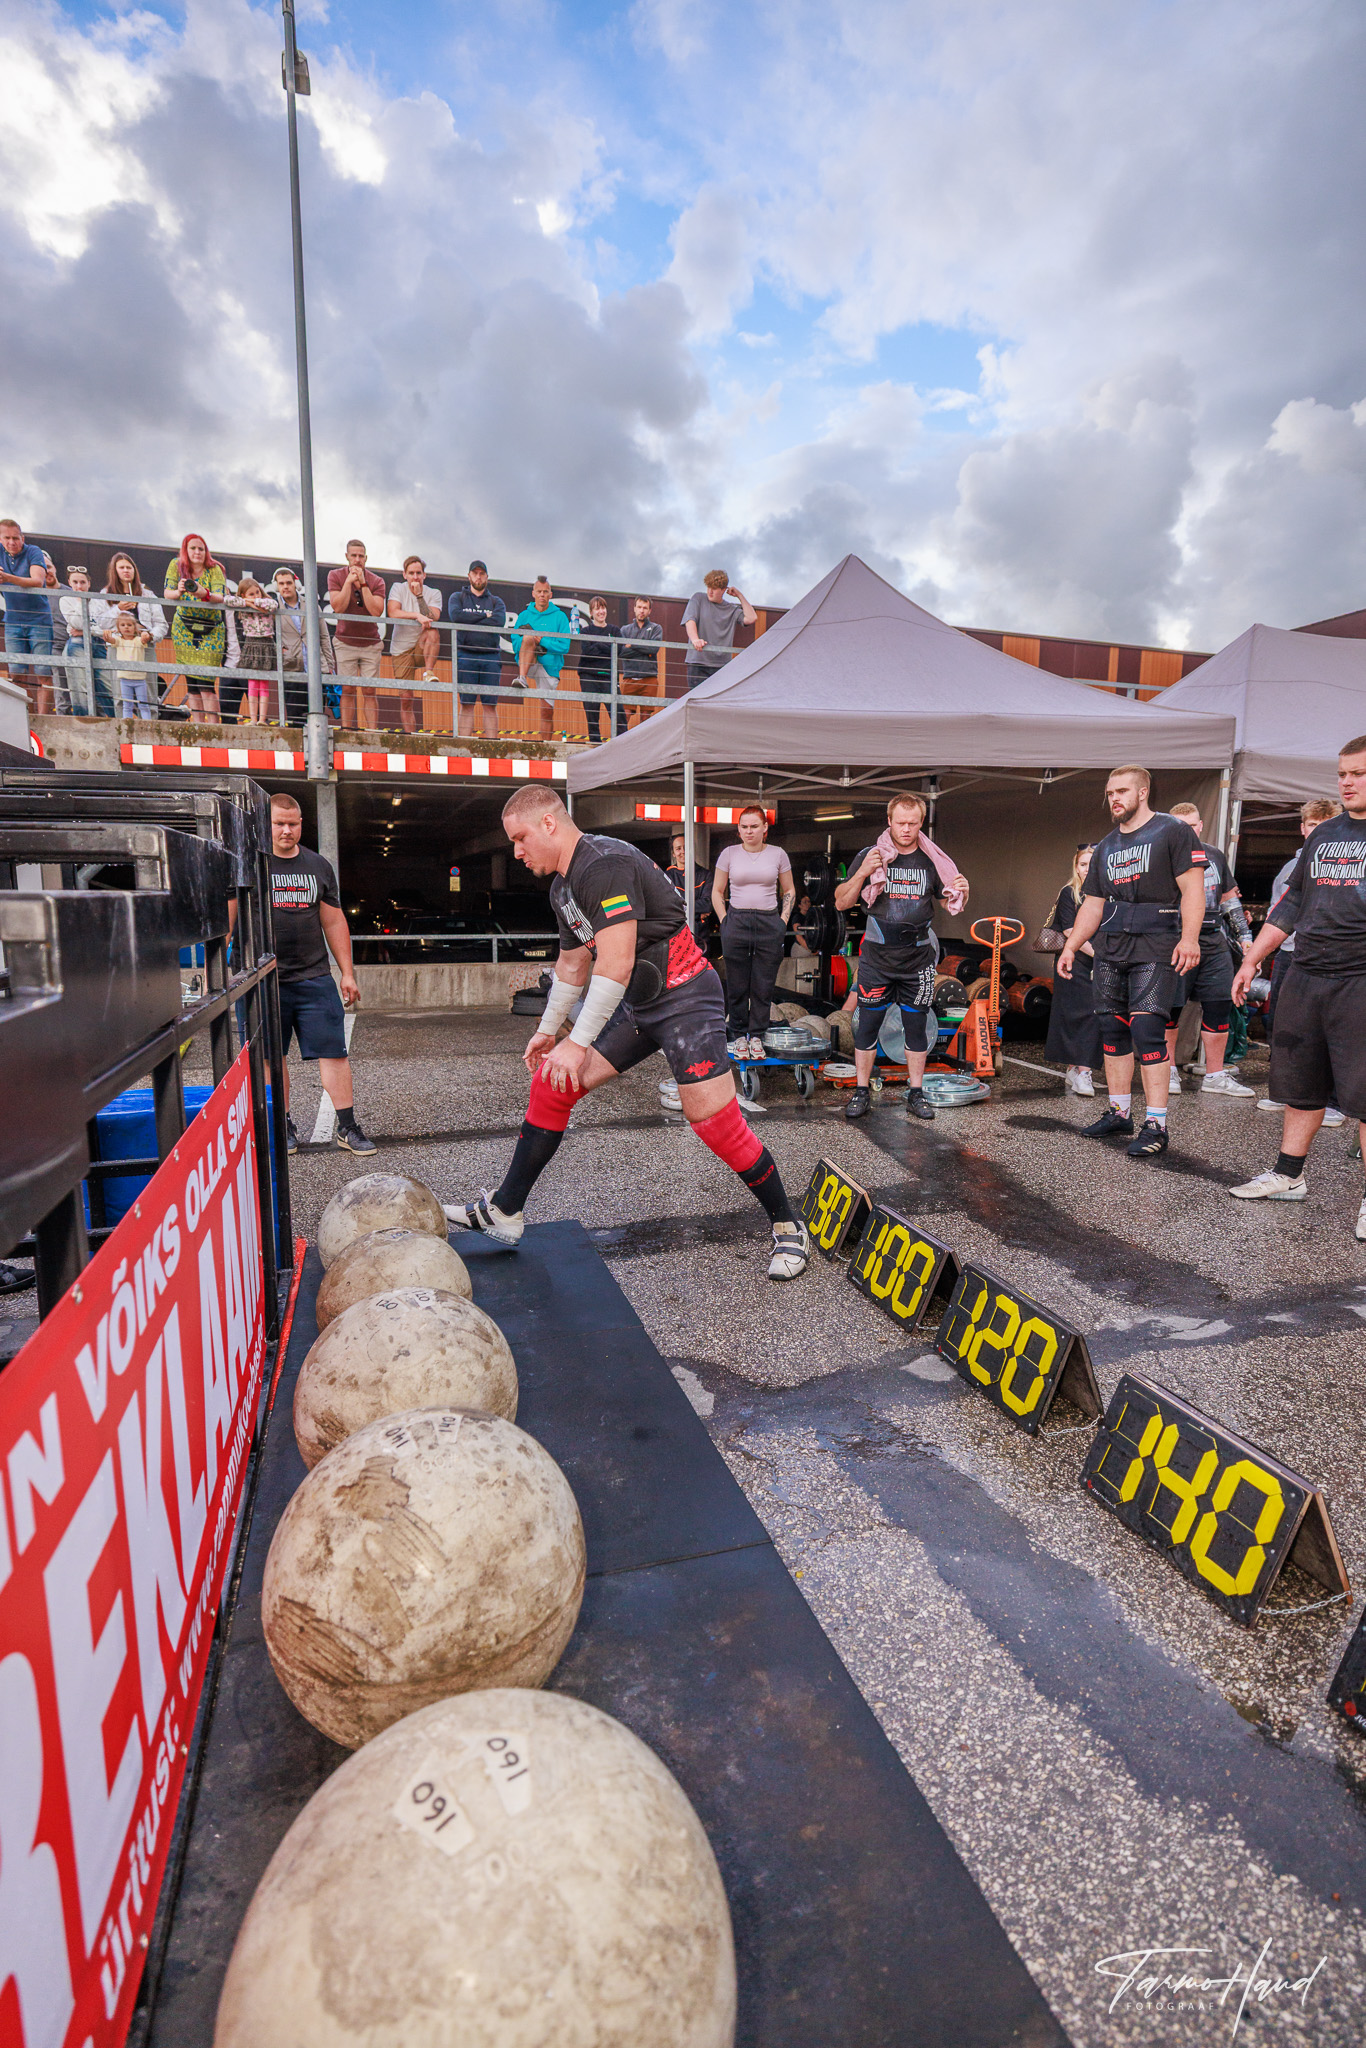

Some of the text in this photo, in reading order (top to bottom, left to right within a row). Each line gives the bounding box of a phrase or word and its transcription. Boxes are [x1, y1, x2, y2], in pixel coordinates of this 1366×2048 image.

[1107, 843, 1151, 867] STRONGMAN
[1316, 878, 1341, 886] ESTONIA
[978, 1016, 990, 1057] LAADUR
[809, 1174, 853, 1251] 90
[75, 1203, 181, 1424] VÕIKS
[185, 1139, 228, 1234] OLLA
[227, 1075, 249, 1154] SINU
[861, 1220, 937, 1319] 100
[375, 1299, 399, 1311] 120
[955, 1285, 1058, 1417] 120
[385, 1427, 410, 1449] 140
[438, 1416, 456, 1433] 140
[1119, 1412, 1285, 1597] 140
[486, 1737, 529, 1783] 160
[411, 1781, 458, 1833] 160
[101, 1695, 181, 2021] üritust:
